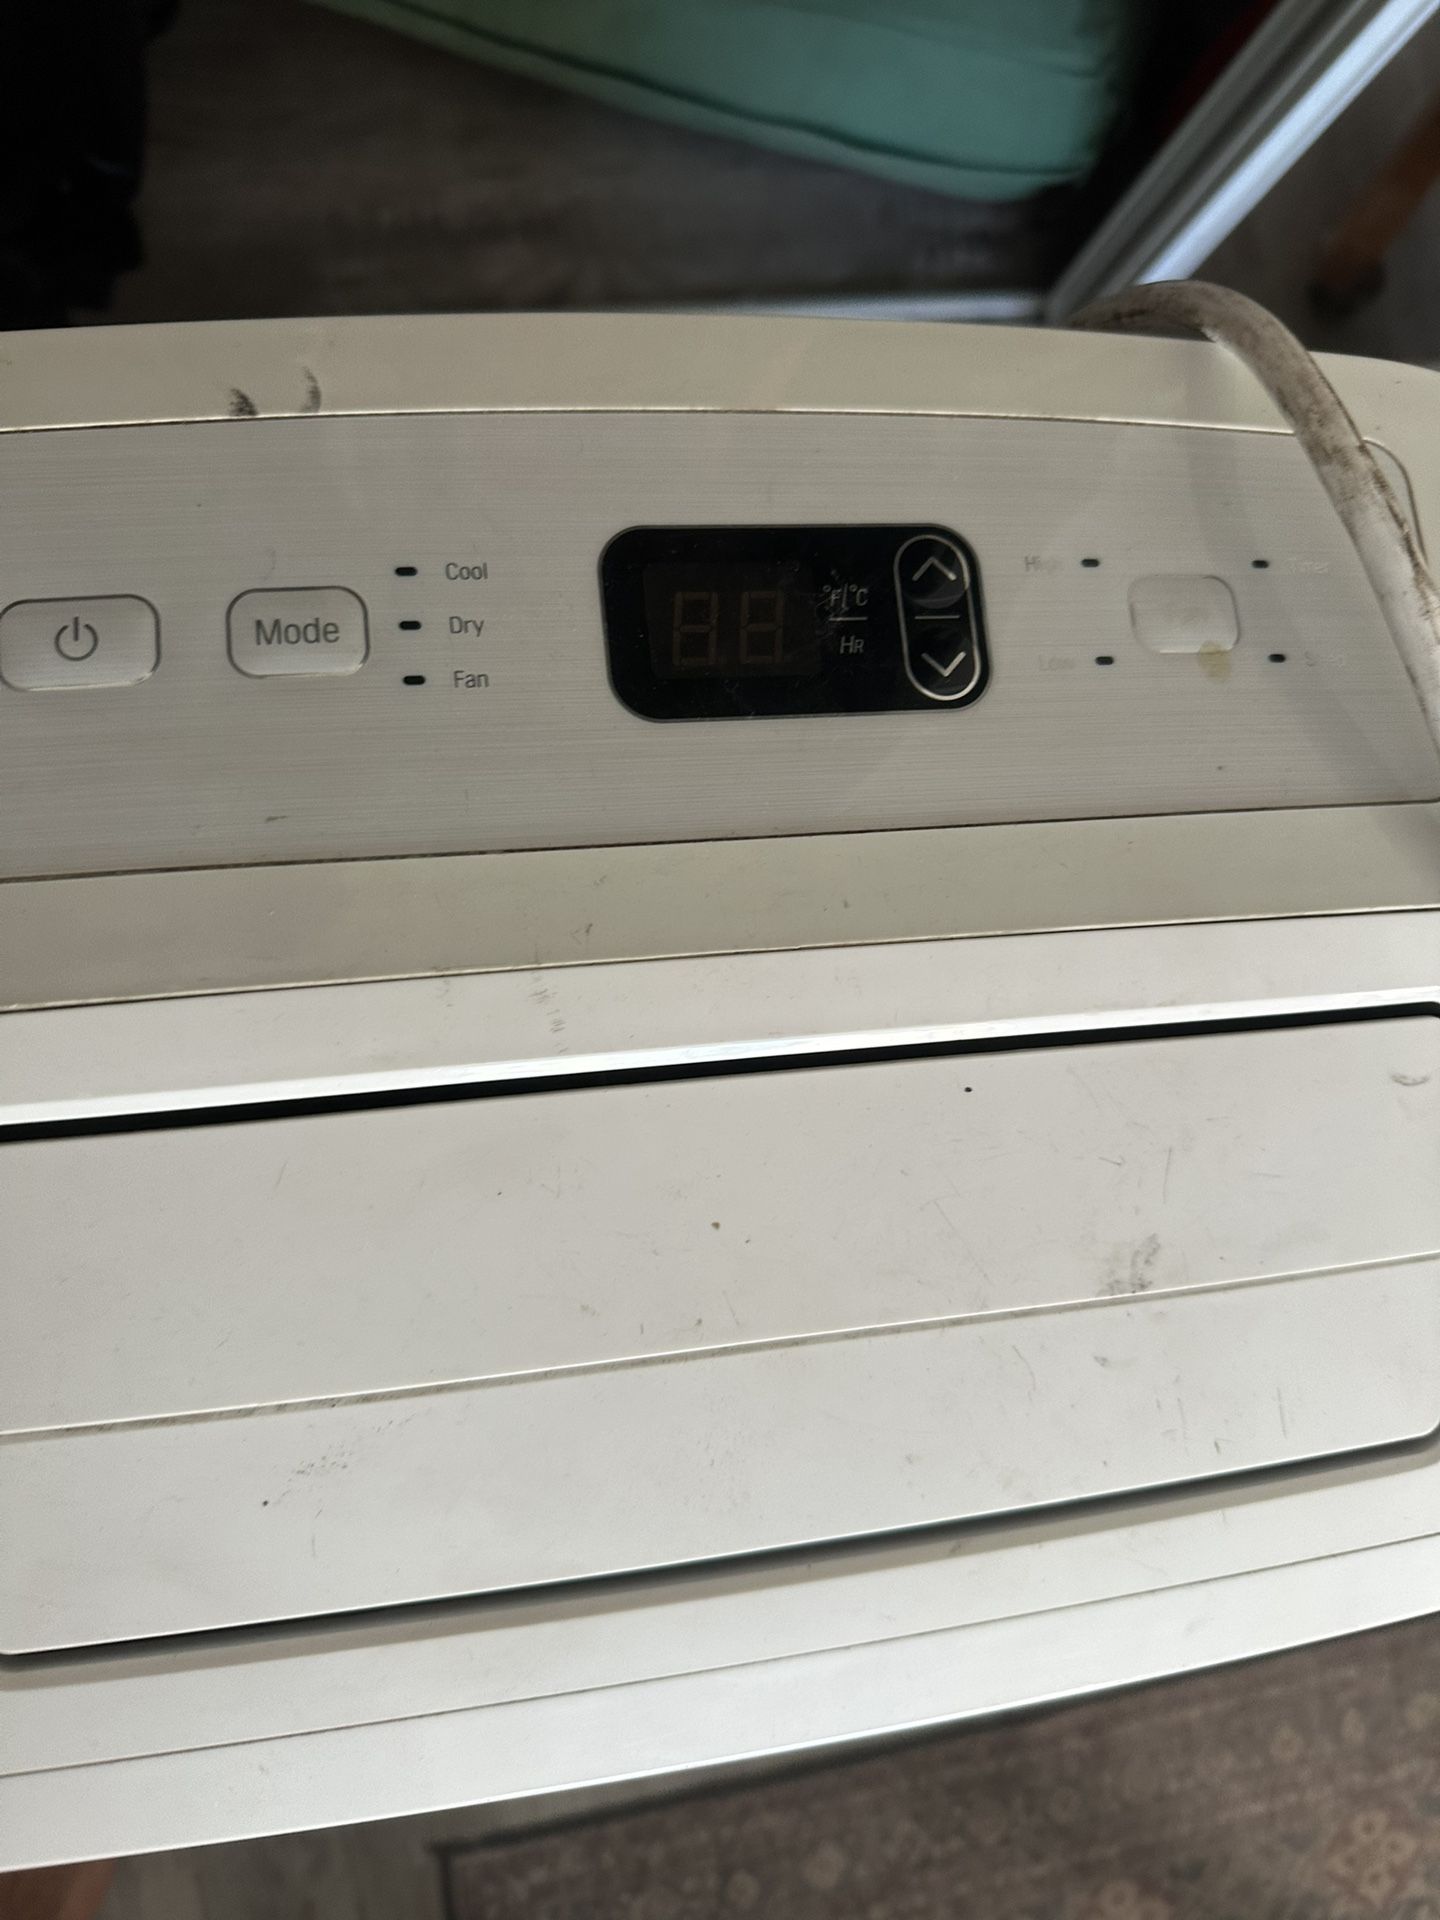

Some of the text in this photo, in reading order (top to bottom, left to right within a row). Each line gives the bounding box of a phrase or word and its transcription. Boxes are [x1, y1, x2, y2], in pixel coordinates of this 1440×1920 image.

[445, 563, 488, 580] Cool
[255, 617, 340, 645] Mode
[450, 616, 484, 637] Dry
[453, 670, 489, 688] Fan
